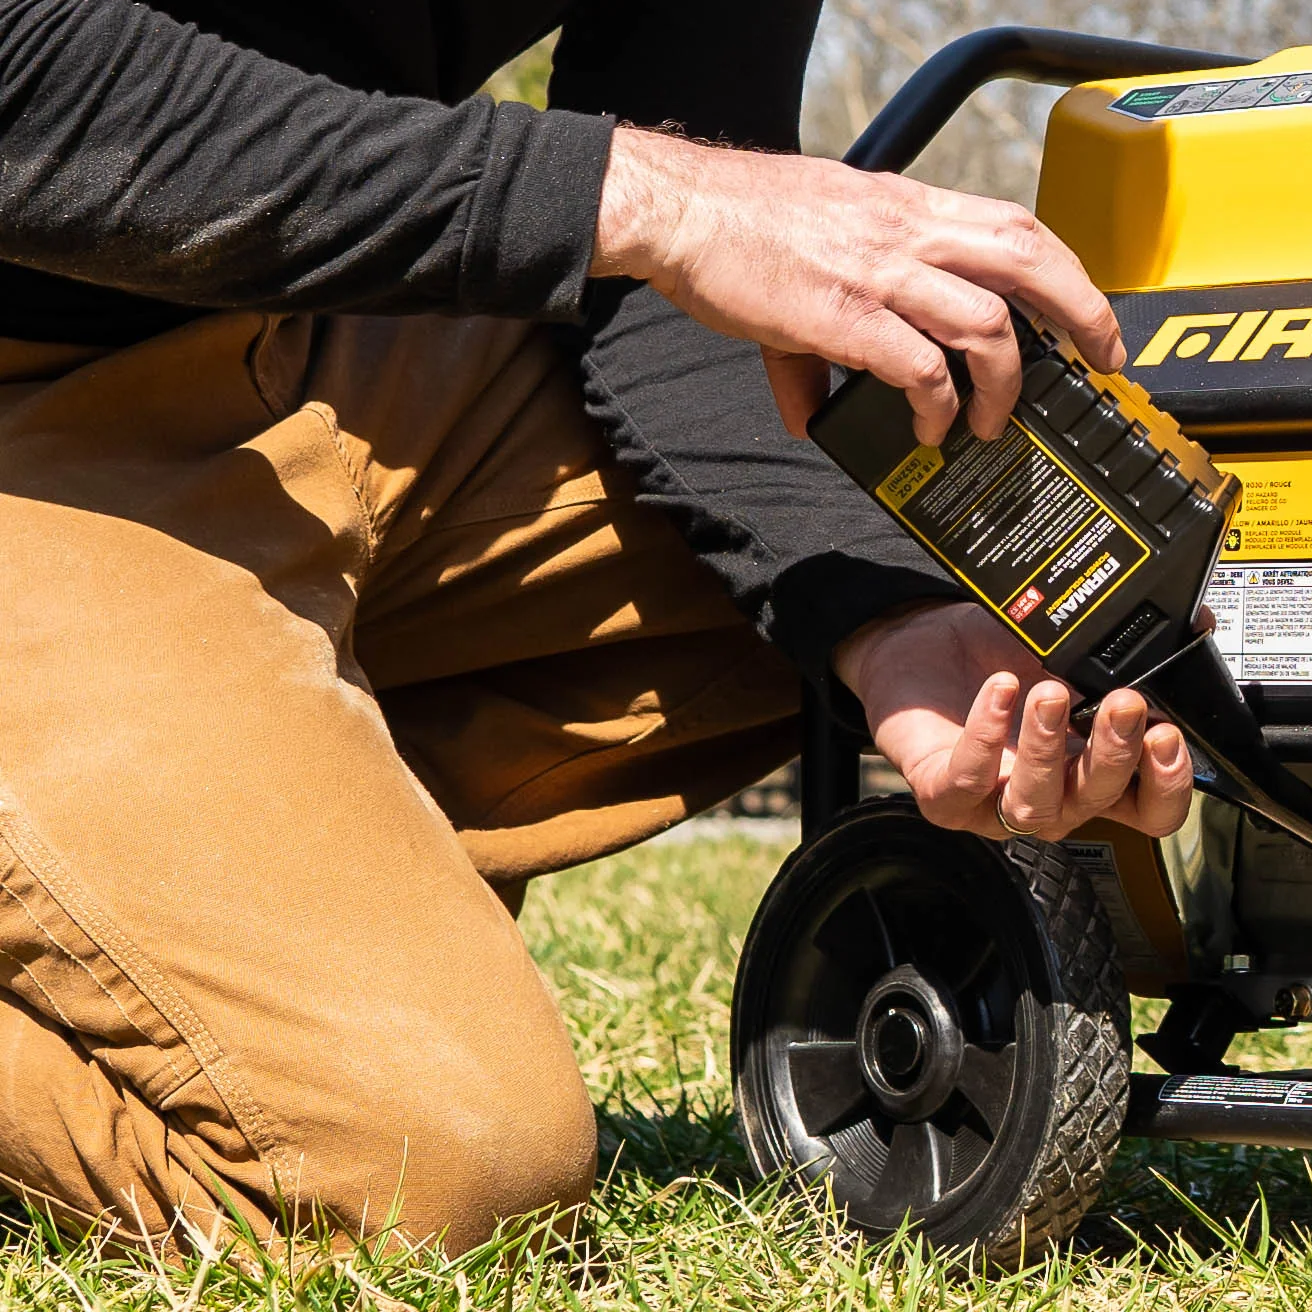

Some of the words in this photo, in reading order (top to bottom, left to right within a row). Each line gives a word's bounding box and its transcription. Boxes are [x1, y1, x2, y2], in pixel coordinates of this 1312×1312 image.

[1269, 480, 1292, 488] ROUGE
[1256, 519, 1289, 527] AMARILLO
[1082, 550, 1111, 578] POWER
[1043, 575, 1085, 616] EQUIPMENT
[1048, 555, 1121, 626] FIRMAN
